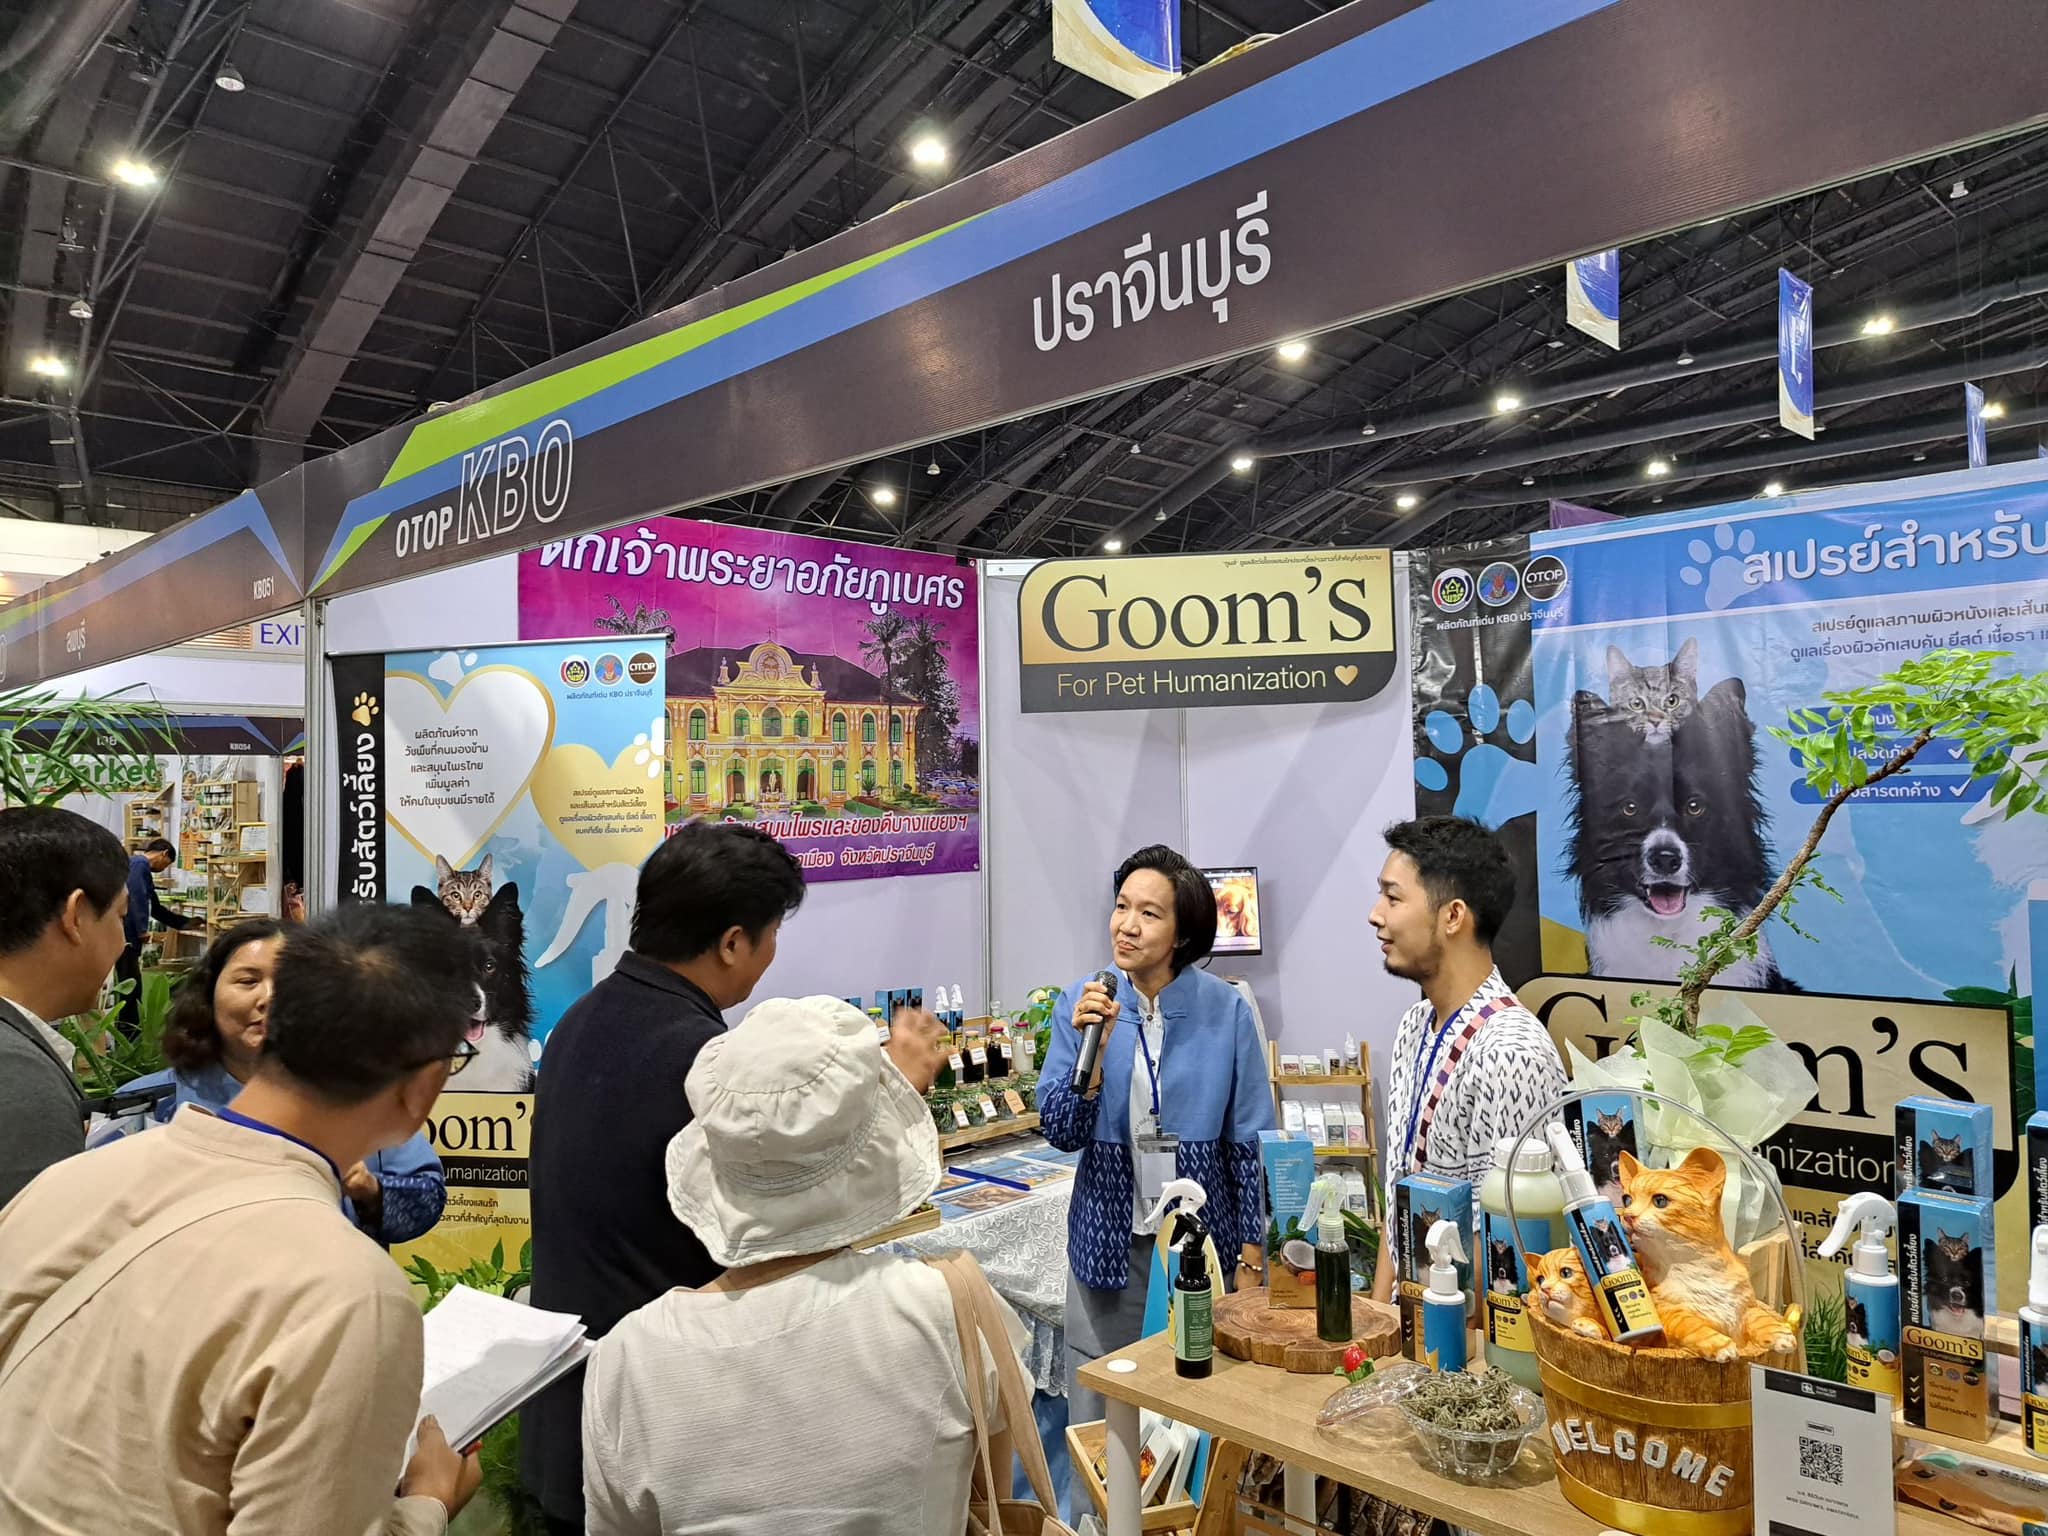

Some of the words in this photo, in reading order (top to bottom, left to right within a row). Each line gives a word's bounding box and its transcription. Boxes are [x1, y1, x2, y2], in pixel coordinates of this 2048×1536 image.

[1033, 190, 1272, 351] ปราจีนบุรี
[396, 506, 453, 558] OTOP
[457, 419, 573, 545] KBO
[539, 527, 965, 615] ตกเจ้าพระยาอภัยภูเบศร
[1526, 569, 1563, 583] OTOP
[1041, 566, 1371, 652] Goom's
[1497, 613, 1517, 624] KBO
[1520, 606, 1564, 622] ปราจีนบุรี
[1812, 599, 2048, 633] สเปรย์ดูแลสภาพผิวหนังและเส้น
[1791, 634, 1943, 662] ดูแลเรื่องผิวอักเสบคัน
[1949, 629, 1983, 648] ยีสต์
[1988, 623, 2035, 644] เชื้อรา
[629, 663, 655, 671] OTOP
[1057, 674, 1097, 697] For
[1106, 671, 1145, 696] Pet
[1154, 664, 1326, 694] Humanization
[405, 741, 488, 756] วัชพืชที่คนมองข้าม
[411, 761, 483, 775] และสมุนไพรไทย
[426, 774, 470, 791] เพิ่มมูลค่า
[400, 792, 495, 808] ให้คนในชุมชนมีรายได้
[343, 733, 376, 904] รับสัตว์เลี้ยง
[842, 842, 935, 865] จังหวัดปราจีนบุรี
[1906, 1328, 1980, 1358] Goom's
